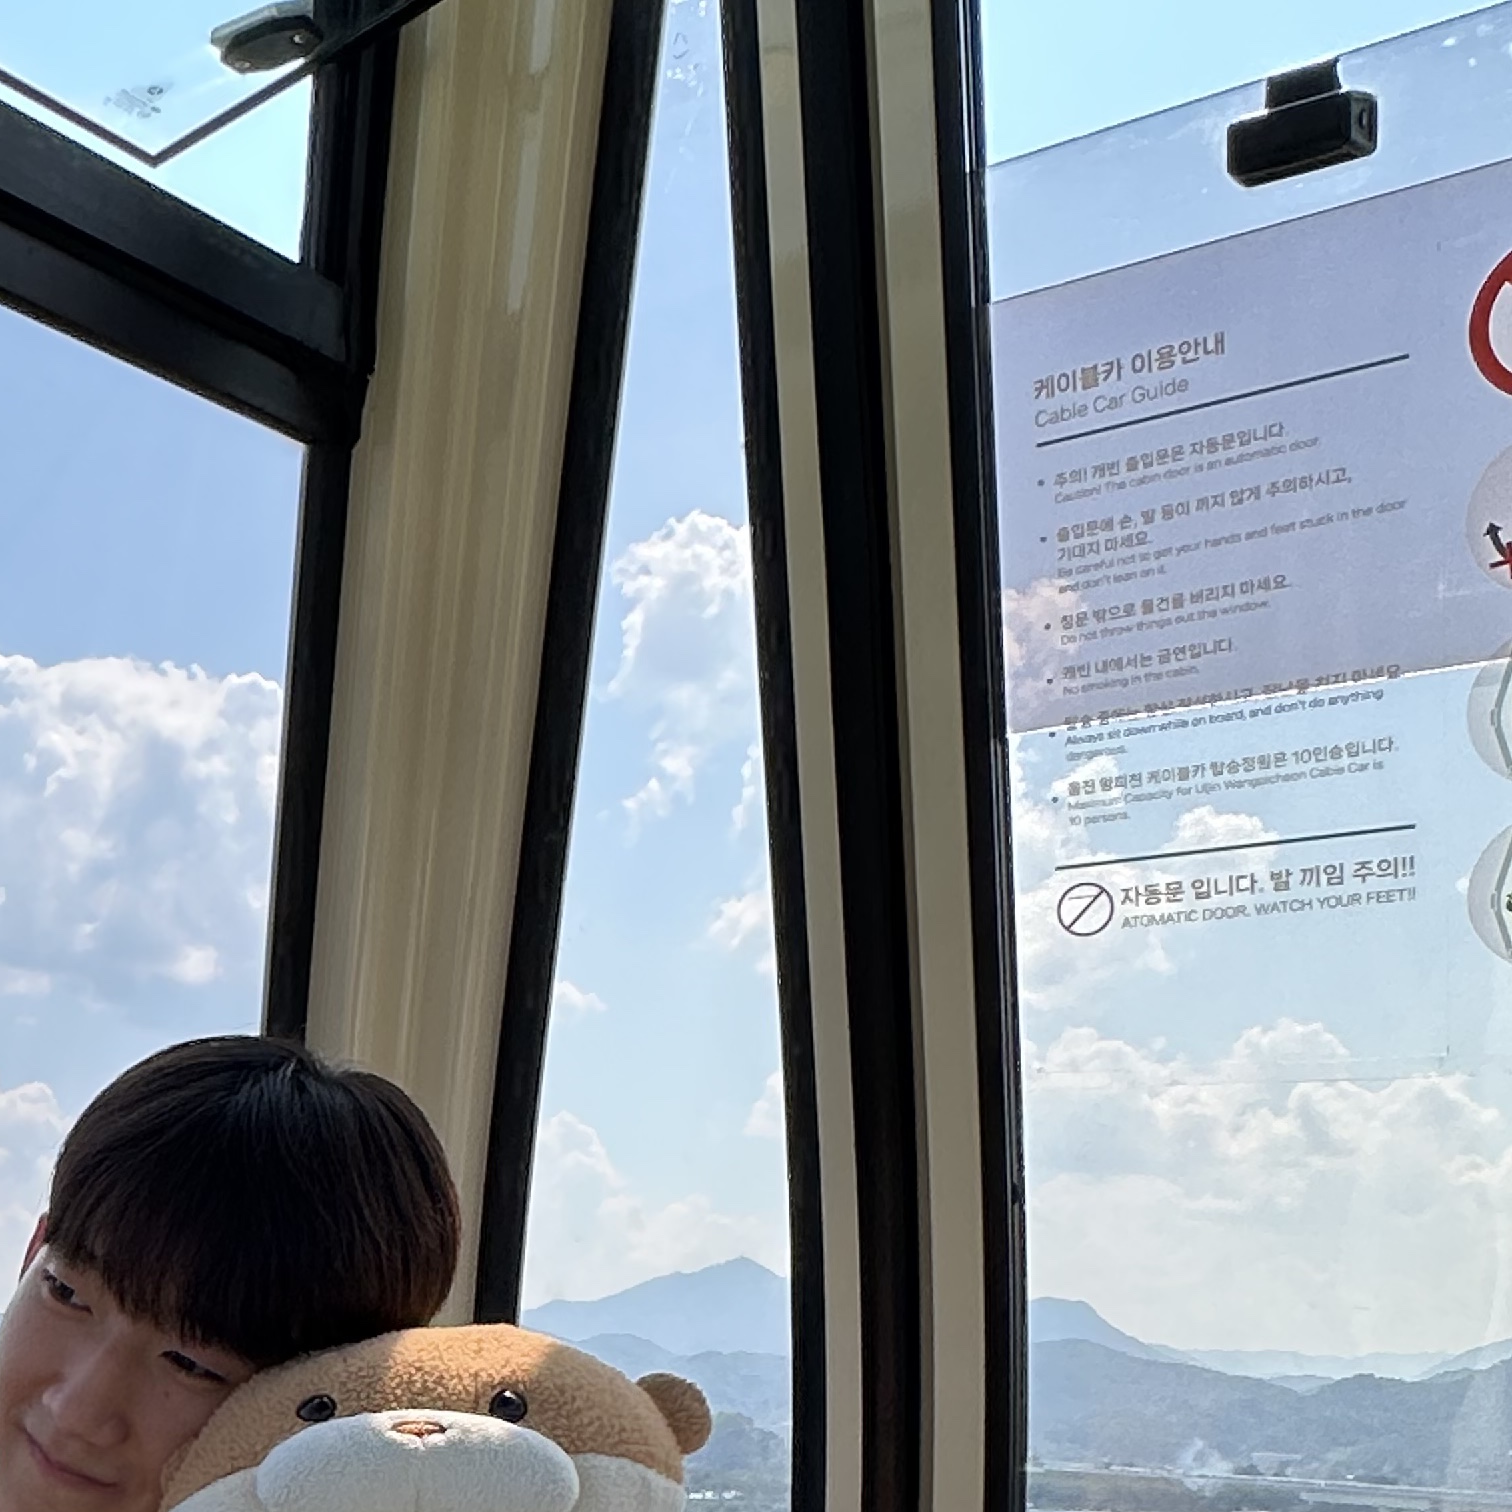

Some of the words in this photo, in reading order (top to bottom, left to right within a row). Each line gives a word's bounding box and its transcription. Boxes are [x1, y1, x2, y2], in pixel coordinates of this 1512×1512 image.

[1033, 357, 1125, 400] 케이블카
[1131, 331, 1225, 374] 이용안내
[1034, 402, 1088, 427] Cable
[1093, 392, 1126, 414] Car
[1131, 377, 1189, 404] Guide
[1266, 467, 1352, 497] 주의하시고,
[1249, 705, 1271, 718] and
[1328, 689, 1384, 706] anything
[1309, 765, 1345, 779] Cable
[1347, 761, 1370, 774] Car
[1372, 759, 1384, 770] is
[1120, 880, 1185, 907] 자동문
[1191, 872, 1265, 900] 입니다.
[1269, 868, 1293, 892] 발
[1299, 862, 1345, 888] 끼임
[1352, 855, 1416, 882] 주의!!
[1120, 909, 1199, 930] ATOMATIC
[1254, 899, 1314, 916] WATCH
[1319, 893, 1363, 911] YOUR
[1366, 886, 1416, 905] FEET!!
